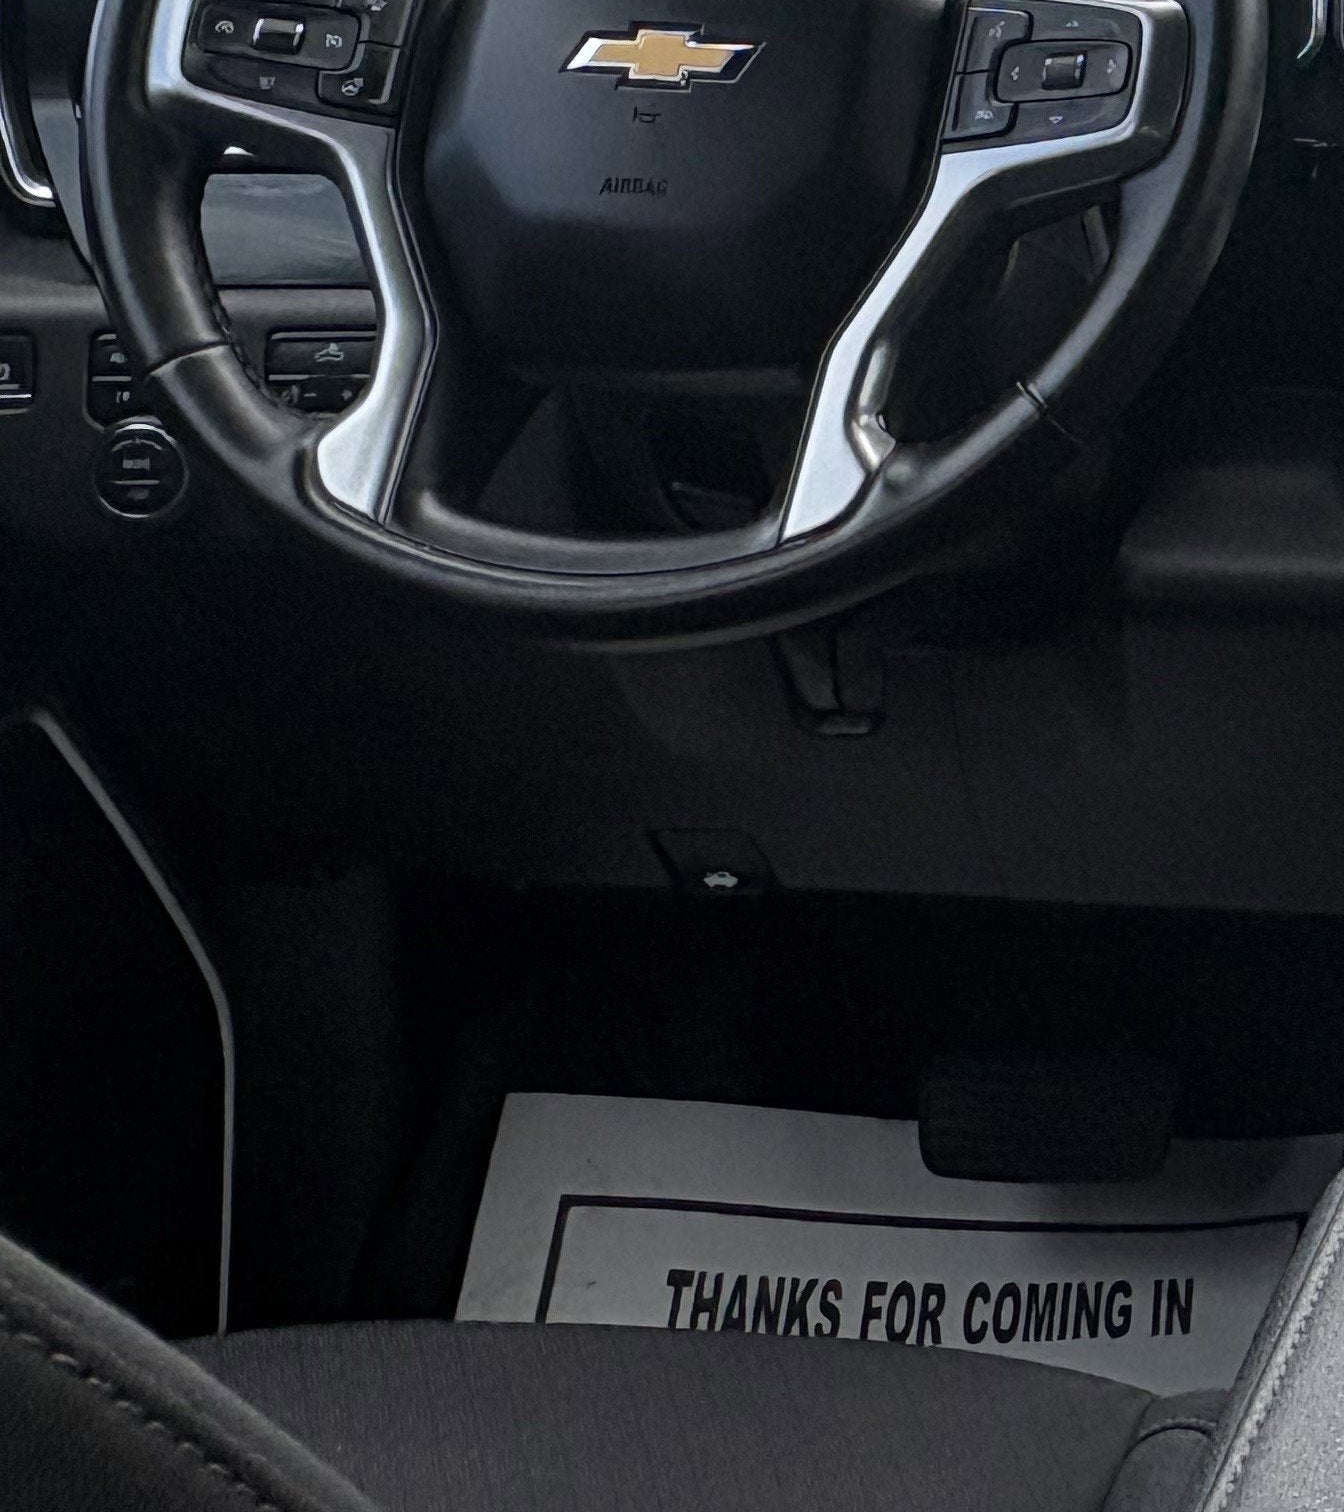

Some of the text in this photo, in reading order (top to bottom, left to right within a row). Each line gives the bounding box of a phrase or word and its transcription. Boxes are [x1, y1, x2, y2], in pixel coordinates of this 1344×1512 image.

[666, 1268, 1195, 1347] THANKS FOR COMING IN
